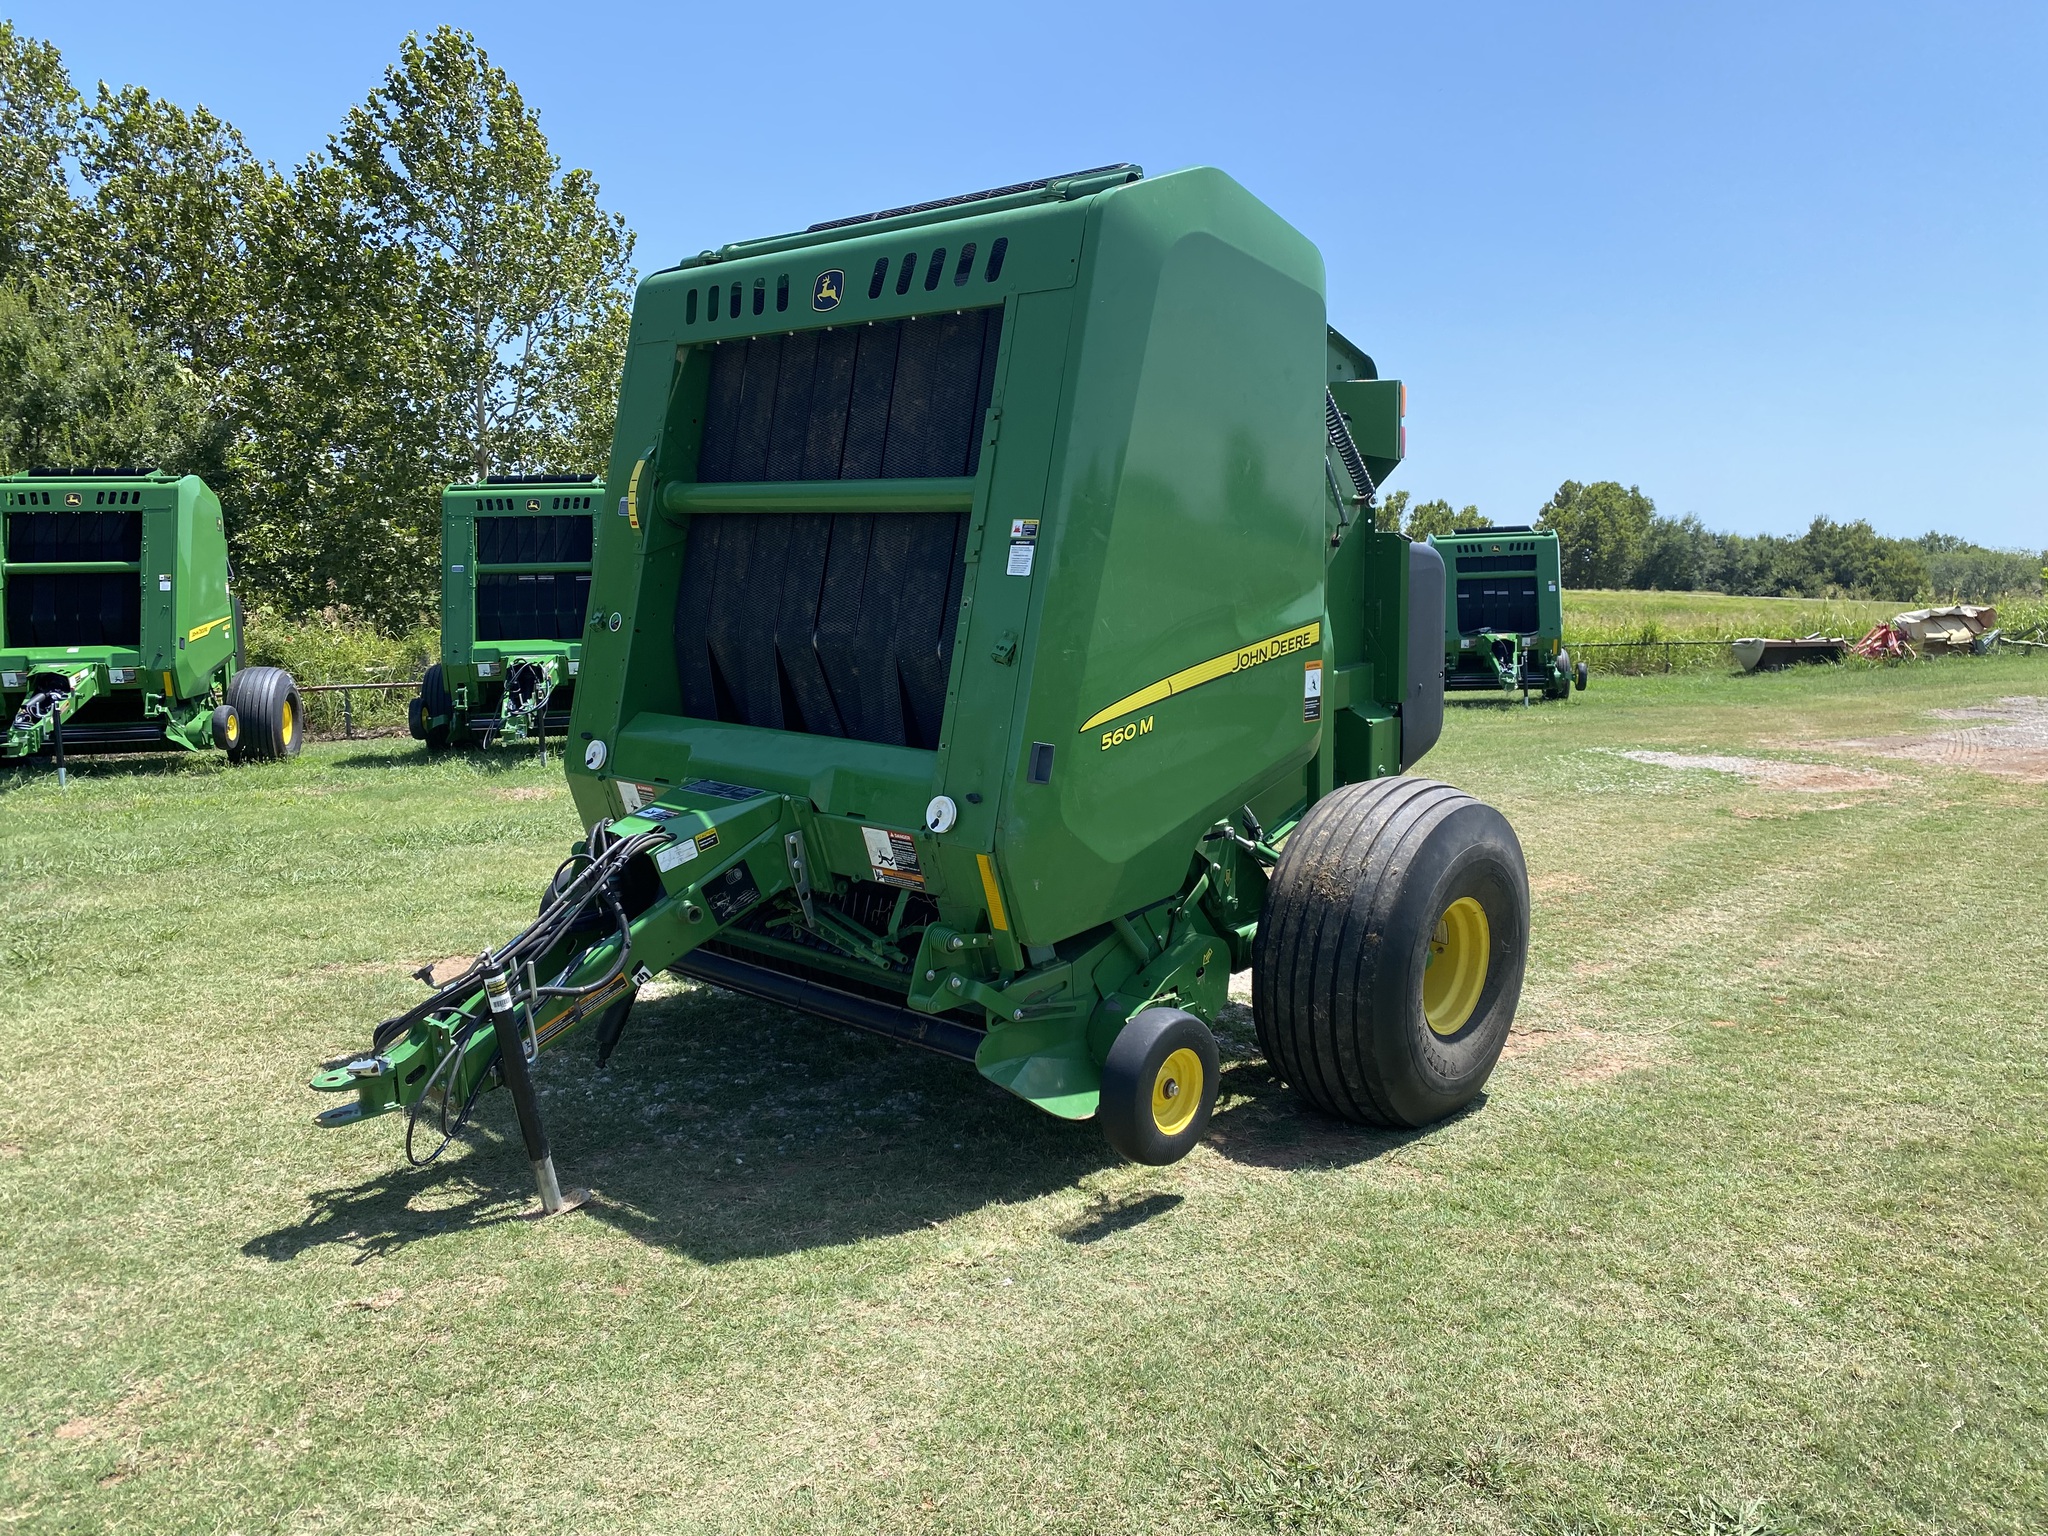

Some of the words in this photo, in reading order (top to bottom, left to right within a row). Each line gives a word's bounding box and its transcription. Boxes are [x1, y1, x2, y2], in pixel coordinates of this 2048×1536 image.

[1232, 647, 1268, 671] JOHN
[1270, 632, 1311, 657] DEERE
[1101, 722, 1137, 751] 560
[1139, 714, 1154, 736] M
